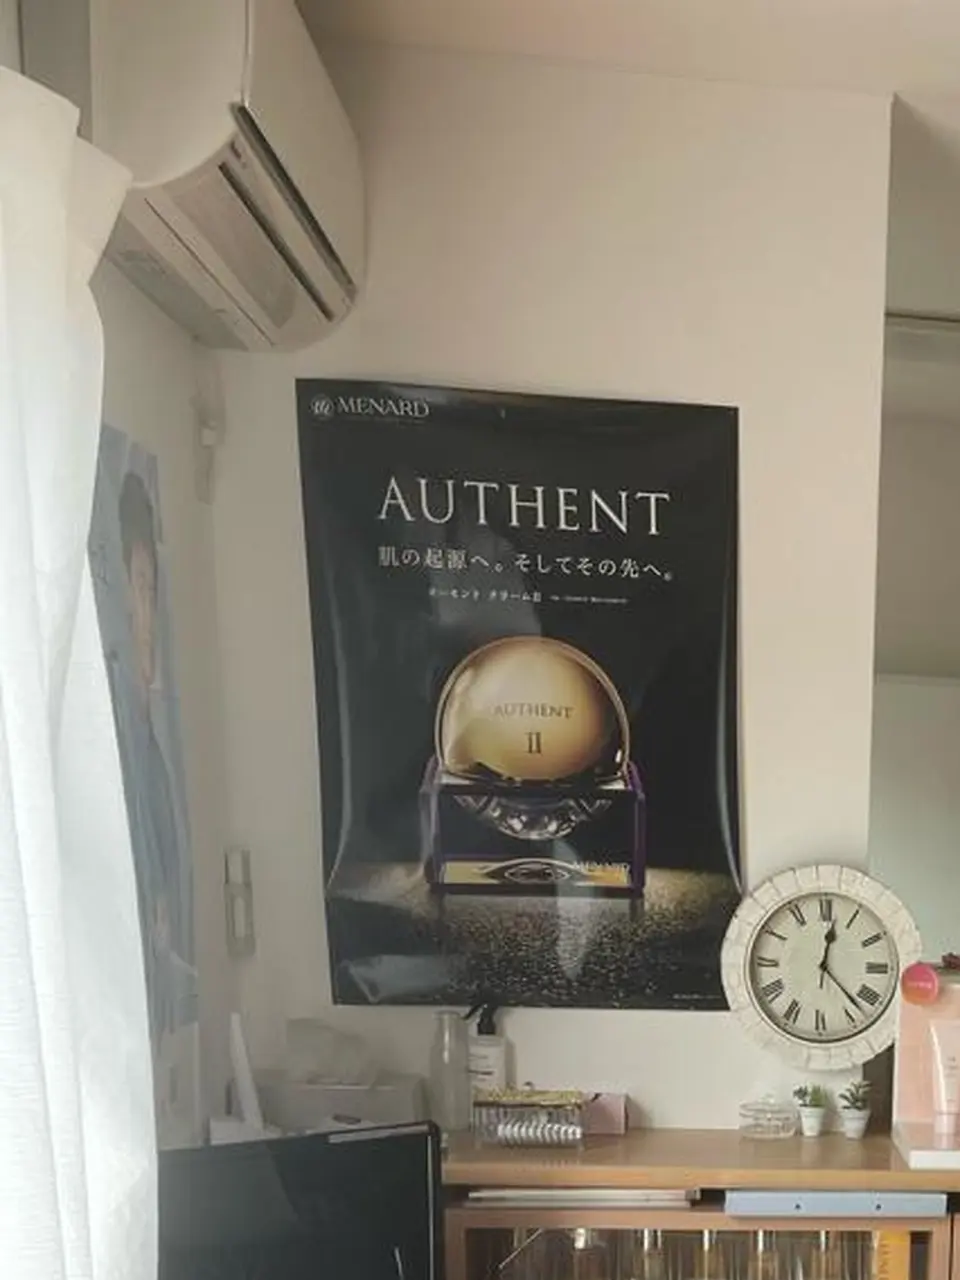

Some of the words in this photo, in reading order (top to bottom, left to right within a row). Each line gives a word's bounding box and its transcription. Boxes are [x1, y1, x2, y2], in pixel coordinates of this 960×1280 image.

[338, 396, 430, 418] MENARD
[377, 475, 672, 536] AUTHENT
[378, 545, 674, 582] 肌の起源へ。そしてその先へ。
[494, 702, 575, 720] AUTHENT
